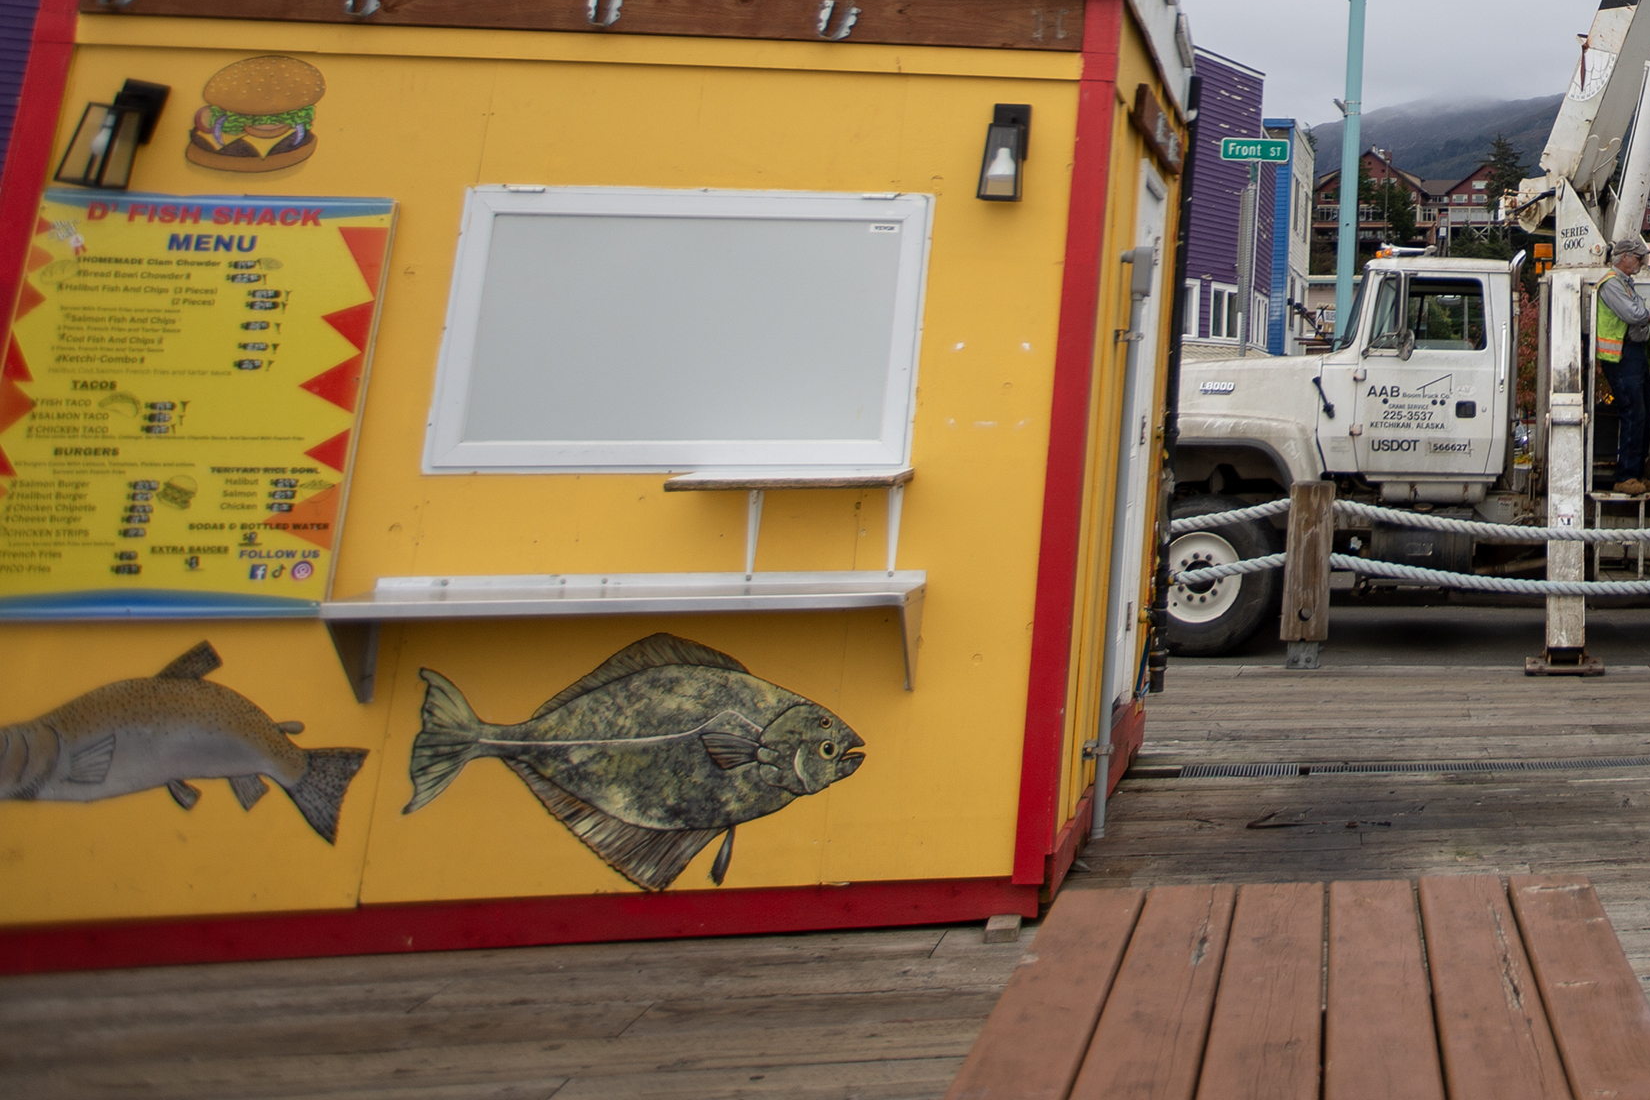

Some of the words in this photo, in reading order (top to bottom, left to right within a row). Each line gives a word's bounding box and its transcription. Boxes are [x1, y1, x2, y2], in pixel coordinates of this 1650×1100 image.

[1228, 143, 1263, 156] Front
[1269, 146, 1282, 157] ST
[87, 202, 118, 221] D'
[128, 203, 202, 224] FISH
[212, 205, 324, 227] SHACK
[1561, 225, 1589, 239] SERIES
[168, 233, 259, 253] MENU
[1564, 237, 1585, 250] 600C
[83, 256, 144, 265] HOMEMADE
[147, 258, 173, 266] Clam
[176, 259, 221, 267] Chowder
[82, 270, 111, 278] Bread
[114, 270, 139, 279] Bowl
[141, 271, 184, 280] Chowder
[65, 284, 99, 292] Halibut
[101, 284, 121, 292] Fish
[122, 285, 141, 293] And
[143, 285, 170, 295] Chips
[71, 315, 106, 323] Salmon
[108, 315, 127, 323] Fish
[128, 316, 148, 324] And
[150, 316, 176, 325] Chips
[66, 336, 85, 344] Cod
[87, 336, 106, 344] Fish
[108, 336, 127, 344] And
[129, 336, 155, 346] Chips
[72, 380, 117, 391] TACOS
[1199, 381, 1235, 391] L8000
[1367, 385, 1400, 398] AAB
[41, 398, 63, 407] FISH
[65, 398, 92, 407] TACO
[38, 412, 81, 420] SALMON
[83, 412, 109, 420] TACO
[1383, 410, 1434, 421] 225-3537
[36, 425, 80, 433] CHICKEN
[83, 425, 109, 434] TACO
[1416, 422, 1445, 430] ALASKA
[1371, 439, 1419, 452] USDOT
[1433, 443, 1467, 451] 566627
[54, 447, 120, 456] BURGERS
[210, 466, 261, 474] TERIYAKI
[18, 480, 55, 488] Salmon
[58, 480, 90, 490] Burger
[225, 477, 259, 486] Halibut
[17, 492, 53, 500] Halibut
[55, 492, 88, 501] Burger
[222, 490, 257, 498] Salmon
[13, 504, 53, 512] Chicken
[54, 504, 97, 514] Chipotle
[220, 502, 258, 511] Chicken
[50, 515, 81, 524] Burger
[188, 523, 226, 531] SODAS
[240, 523, 290, 531] BOTTLED
[292, 523, 330, 531] WATER
[7, 529, 54, 537] CHICKEN
[56, 529, 89, 537] STRIPS
[2, 551, 36, 559] French
[39, 551, 62, 559] Fries
[150, 546, 186, 554] EXTRA
[189, 546, 230, 554] SAUCES
[239, 550, 297, 559] FOLLOW
[302, 550, 320, 559] US
